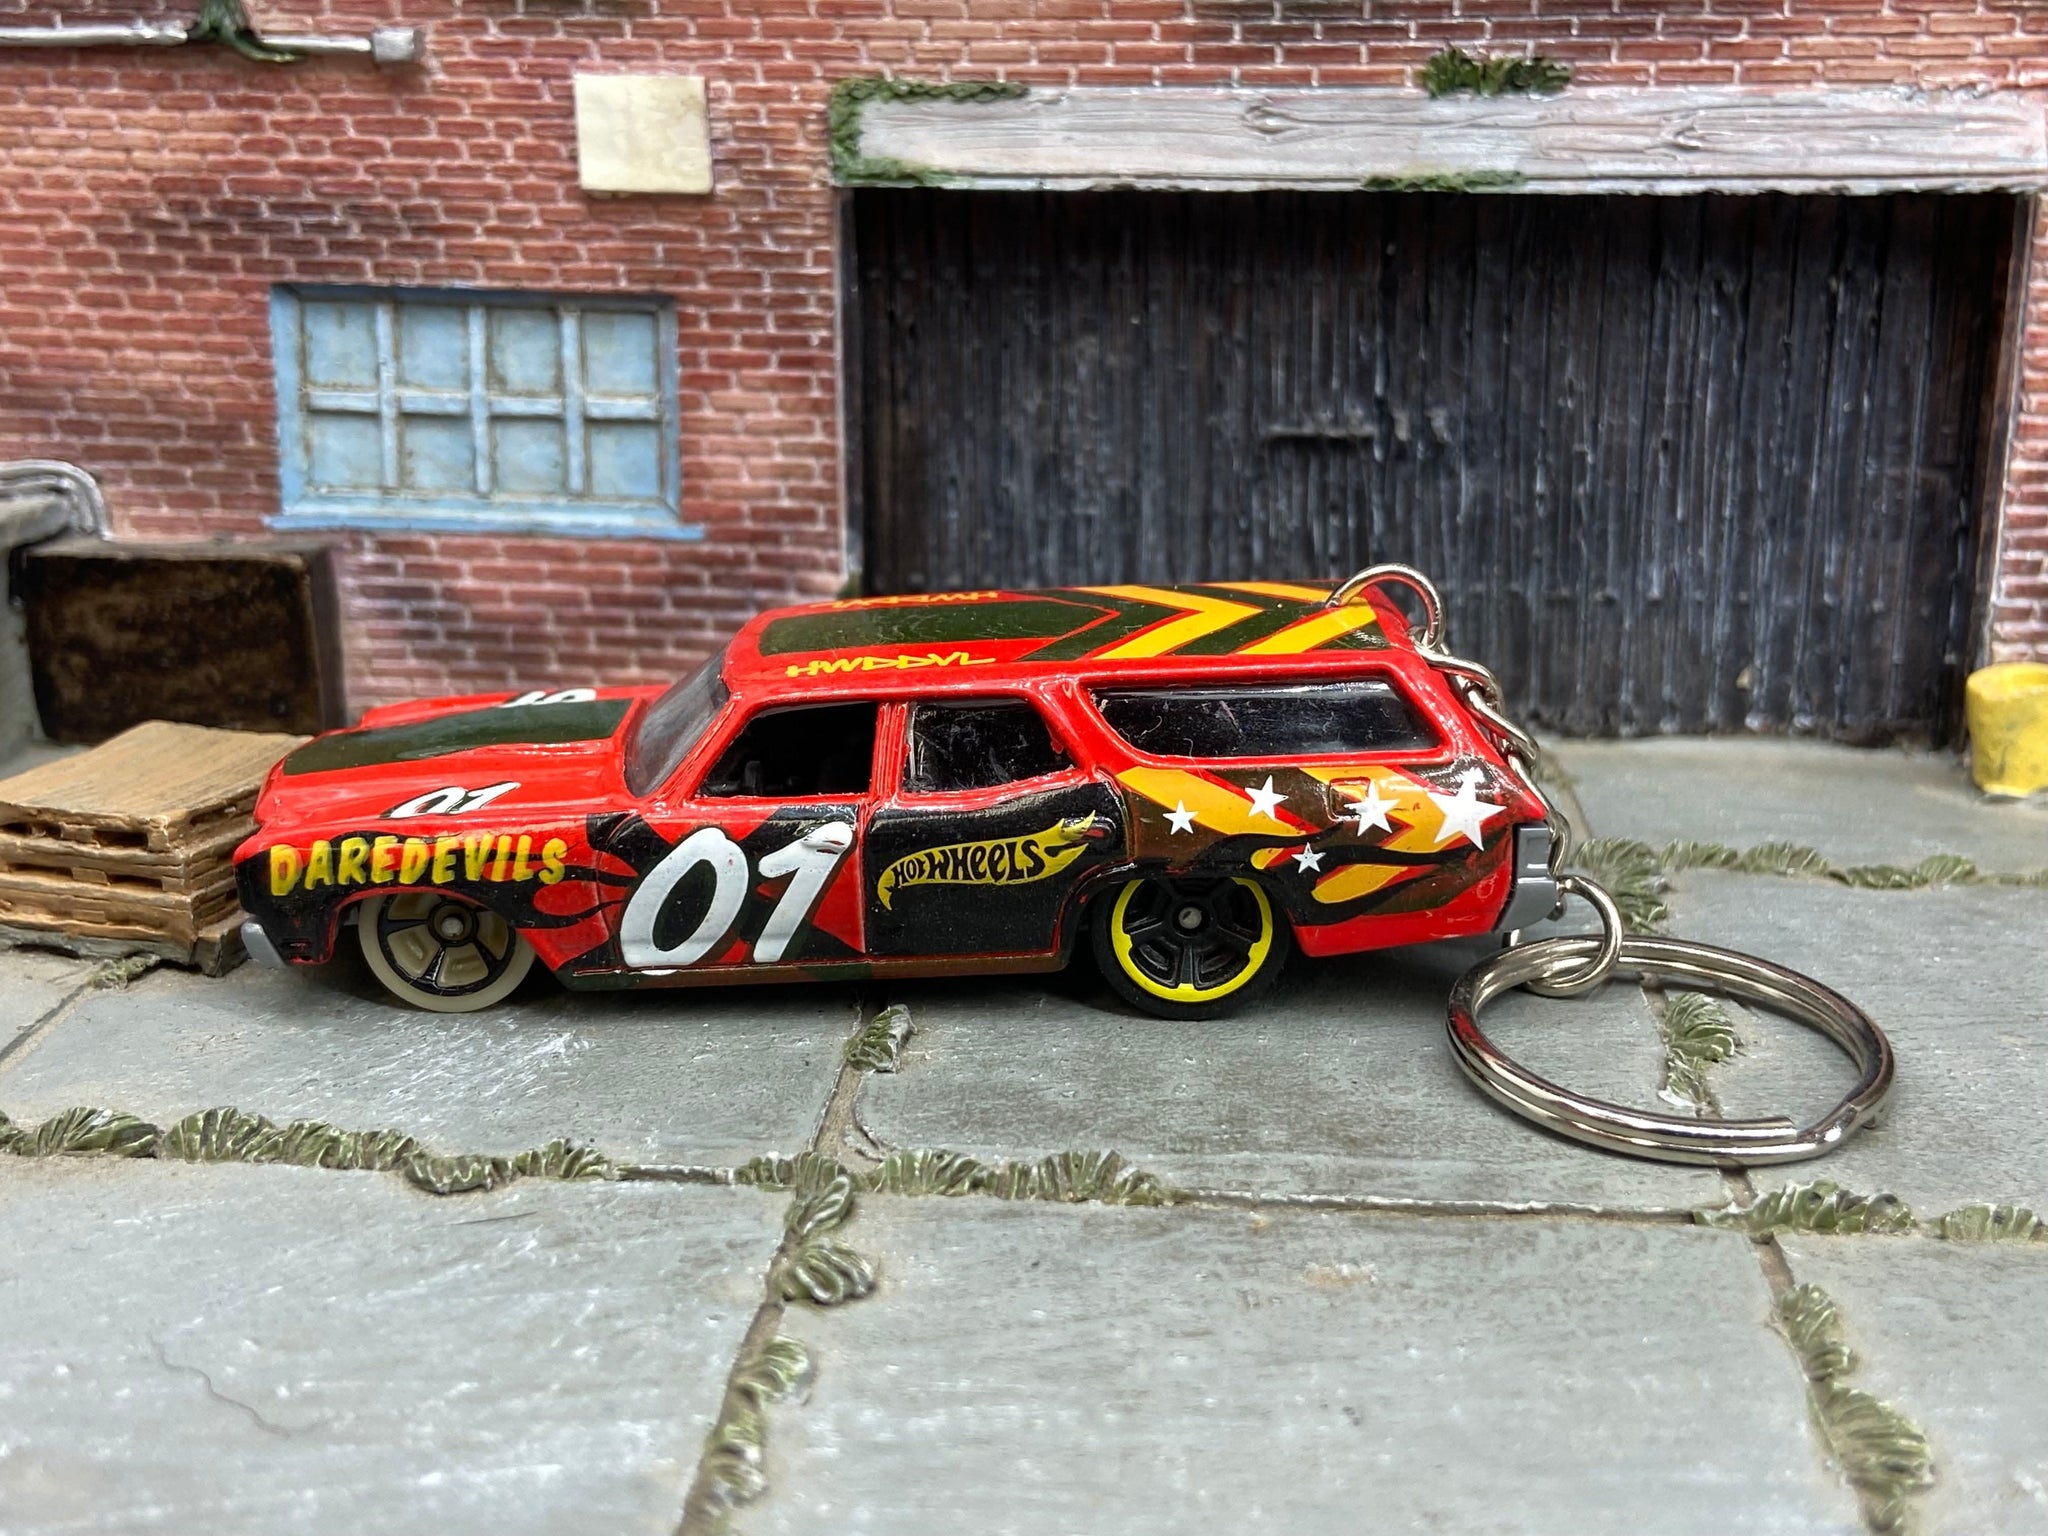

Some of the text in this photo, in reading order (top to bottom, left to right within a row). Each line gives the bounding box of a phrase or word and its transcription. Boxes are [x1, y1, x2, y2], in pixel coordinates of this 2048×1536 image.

[785, 651, 997, 677] HWDDVL
[388, 781, 521, 818] 01
[270, 833, 568, 896] DAREDEVILS
[892, 853, 927, 888] HOT
[620, 821, 854, 967] 01
